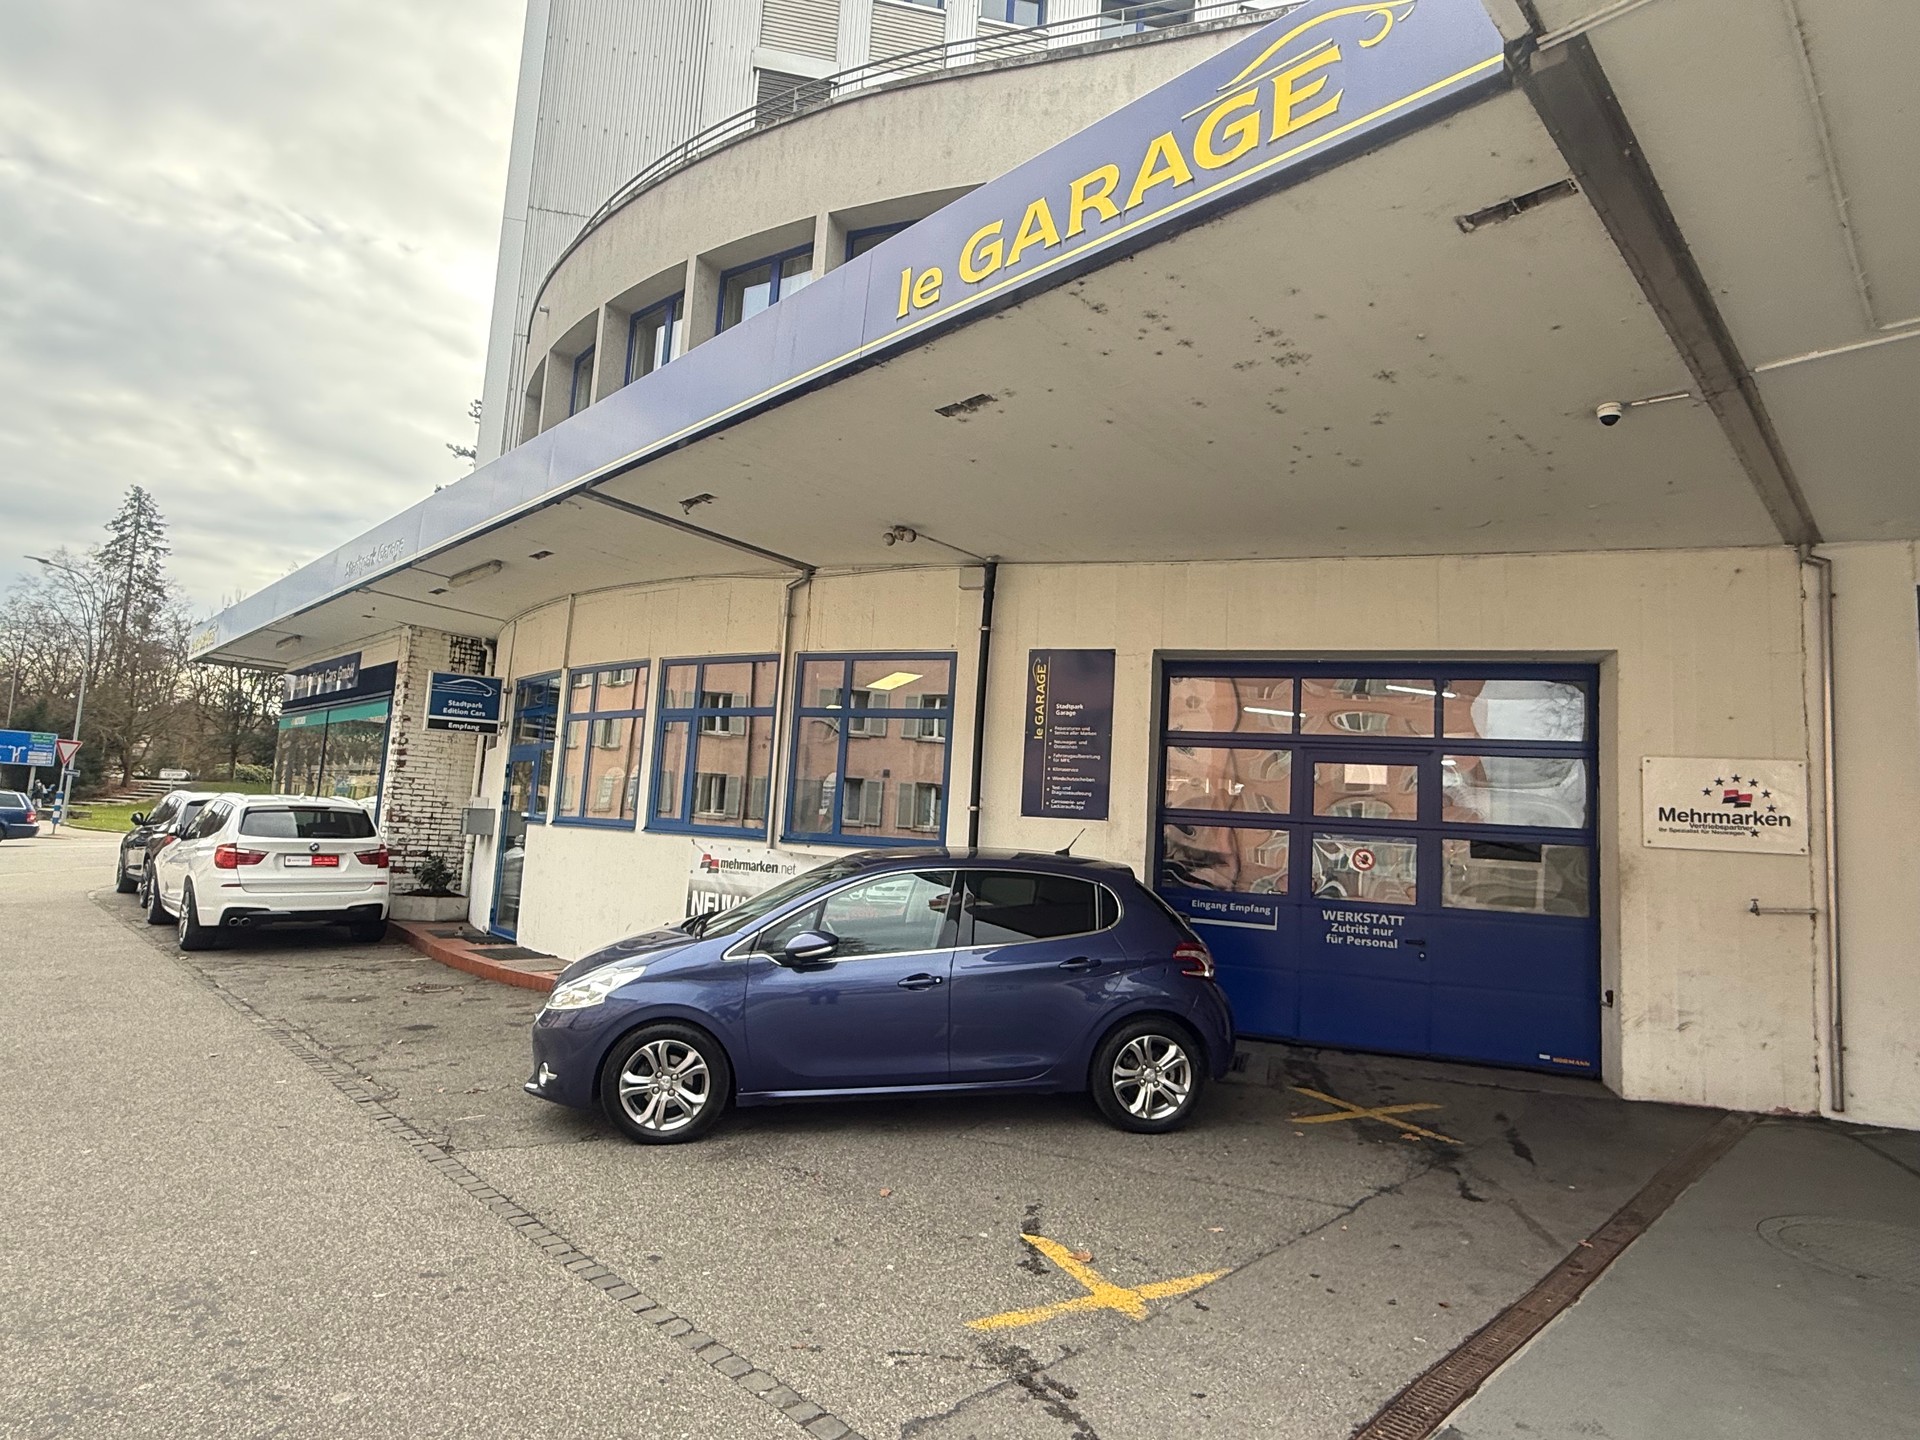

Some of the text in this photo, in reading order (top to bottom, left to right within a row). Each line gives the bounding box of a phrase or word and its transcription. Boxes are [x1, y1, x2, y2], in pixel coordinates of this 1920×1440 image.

[895, 44, 1344, 319] le GARAGE
[324, 668, 337, 684] Cars
[337, 662, 356, 680] GmbH
[447, 699, 483, 709] Stadtpark
[1034, 663, 1047, 740] le GARAGE
[442, 707, 486, 717] Edition Cars
[1055, 709, 1077, 717] Garage
[447, 721, 480, 732] Empfang
[1658, 806, 1791, 827] Mehrmarken
[1669, 827, 1699, 835] Spezialist
[1688, 821, 1754, 832] Vertriebspartner
[720, 857, 797, 876] mehrmarken.net
[1191, 899, 1271, 916] Eingang Empfang
[1322, 909, 1405, 927] WERKSTATT
[1330, 923, 1393, 938] Zutritt nur
[1325, 933, 1399, 949] für Personal
